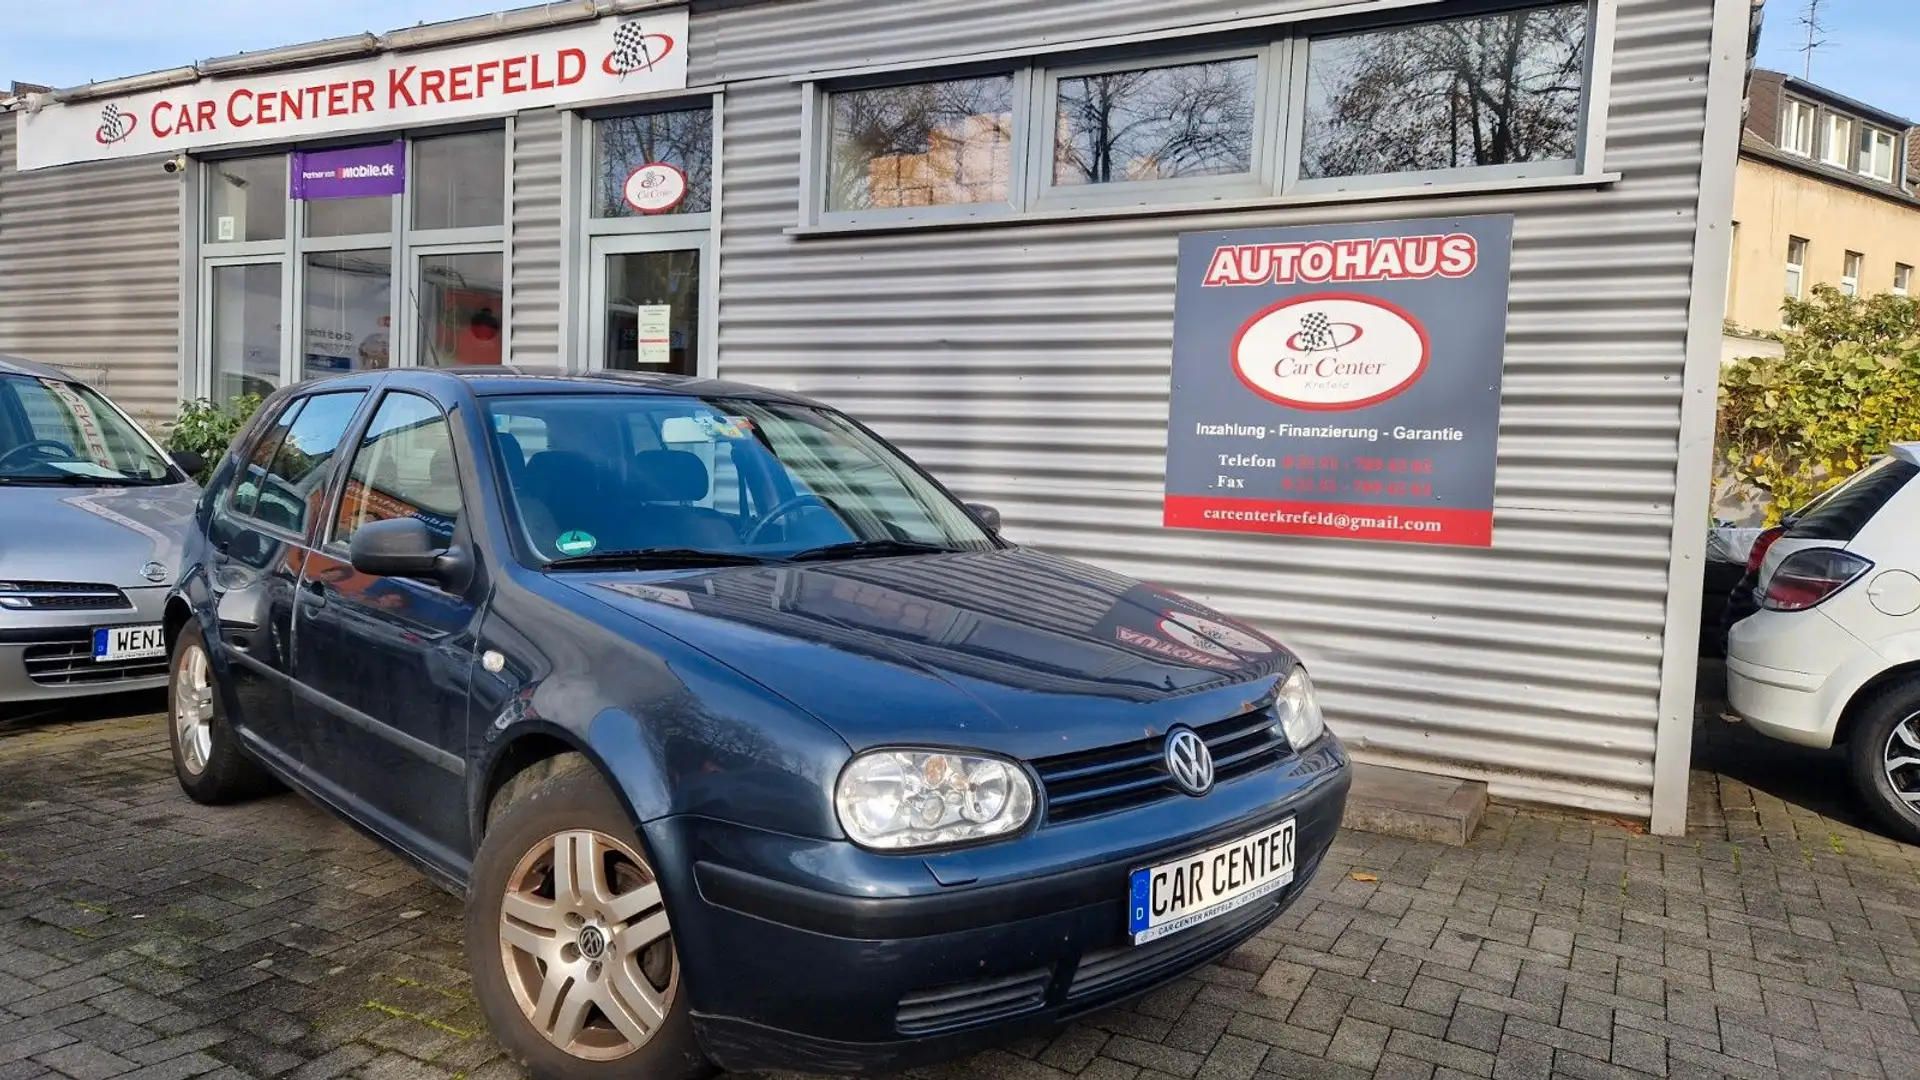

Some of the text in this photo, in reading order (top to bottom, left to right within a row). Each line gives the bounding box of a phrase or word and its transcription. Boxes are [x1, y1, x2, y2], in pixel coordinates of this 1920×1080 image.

[151, 48, 587, 138] CAR CENTER KREFELD
[1203, 233, 1478, 287] AUTOHAUS
[1274, 357, 1386, 378] Car Center
[1196, 422, 1266, 439] Inzahlung
[1279, 424, 1378, 442] Finanzierung
[1393, 426, 1463, 441] Garantie
[1218, 454, 1277, 469] Telefon
[1217, 475, 1245, 489] Fax
[1203, 507, 1442, 533] carcenterkrefeld@gmail.com
[1152, 861, 1204, 917] CAR
[1212, 825, 1293, 896] CENTER
[1136, 907, 1144, 921] D
